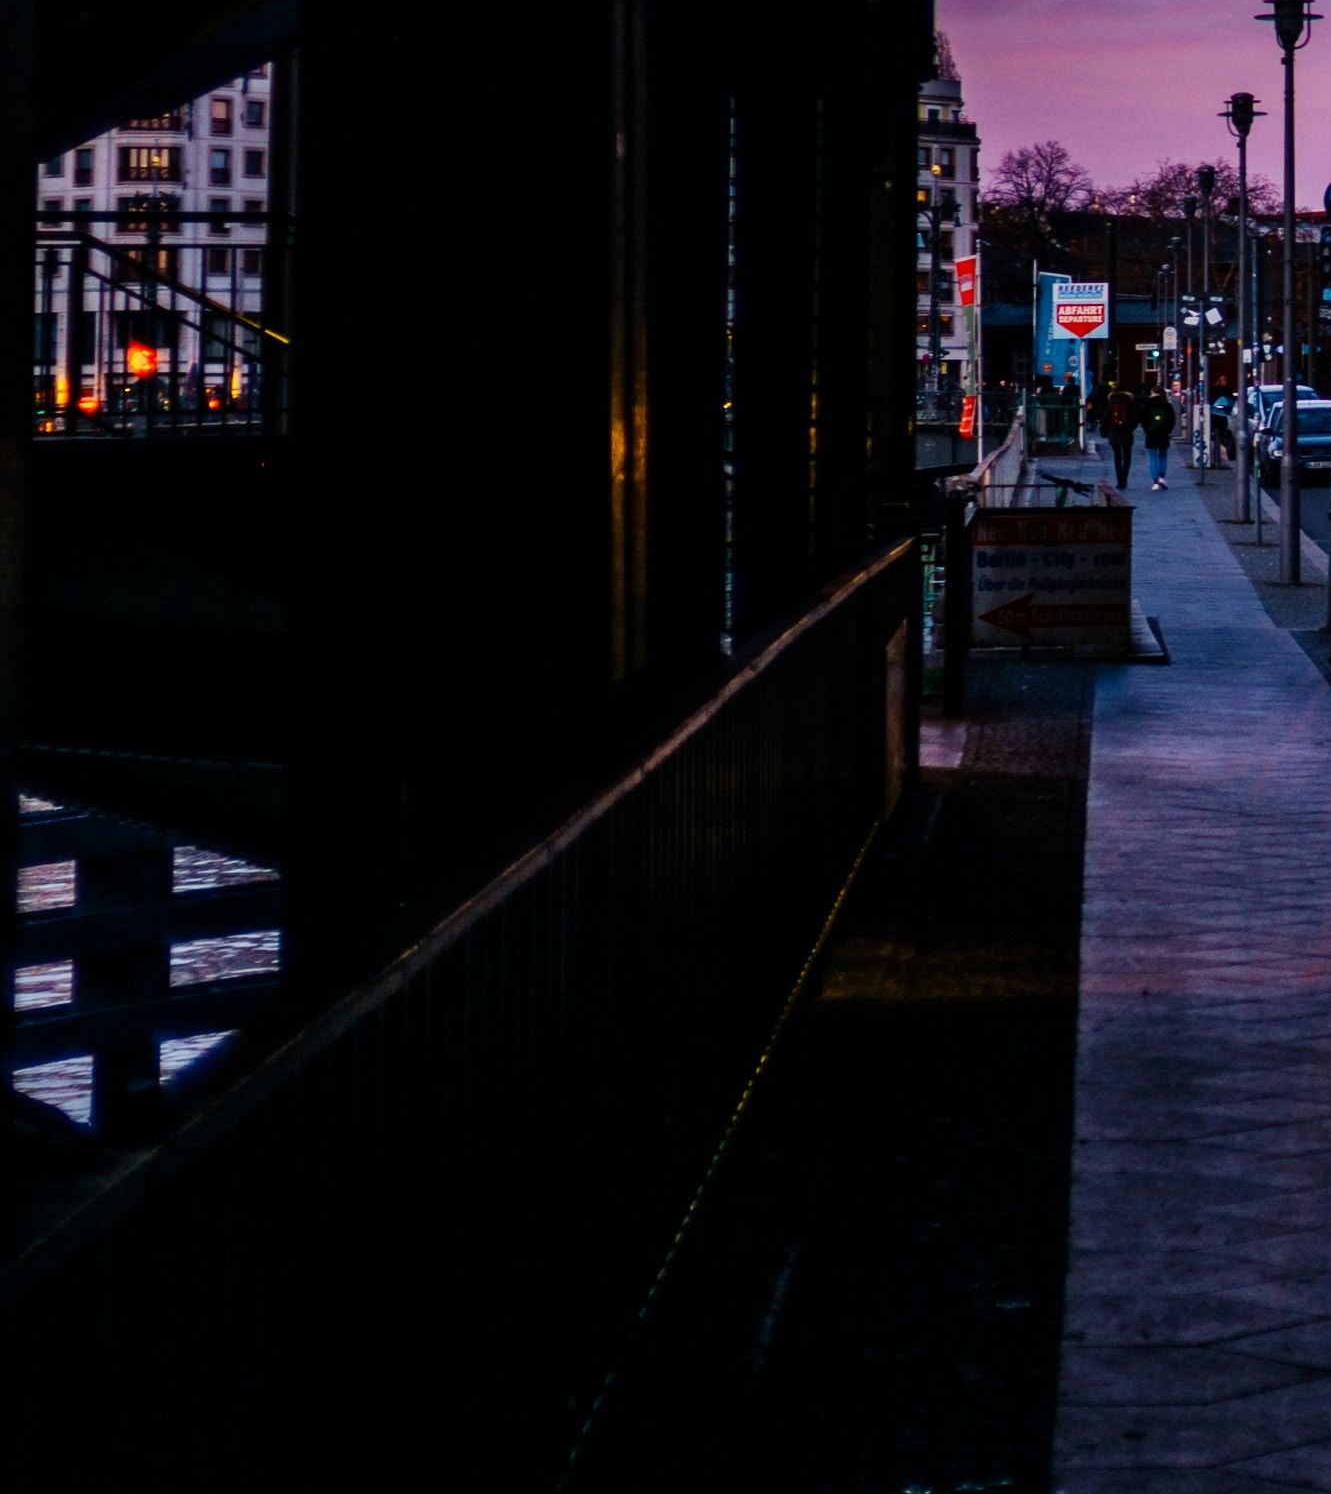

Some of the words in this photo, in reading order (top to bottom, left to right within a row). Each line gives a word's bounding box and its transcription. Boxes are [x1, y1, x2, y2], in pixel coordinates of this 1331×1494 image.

[1058, 306, 1104, 316] ABFAHRT
[977, 521, 1007, 542] Neu
[1017, 520, 1047, 541] Neu
[1057, 519, 1087, 540] Neu
[1098, 518, 1128, 539] Neu
[977, 551, 1027, 568] Berlin
[1043, 551, 1075, 569] City
[978, 575, 1006, 591] Über
[1007, 577, 1026, 591] die
